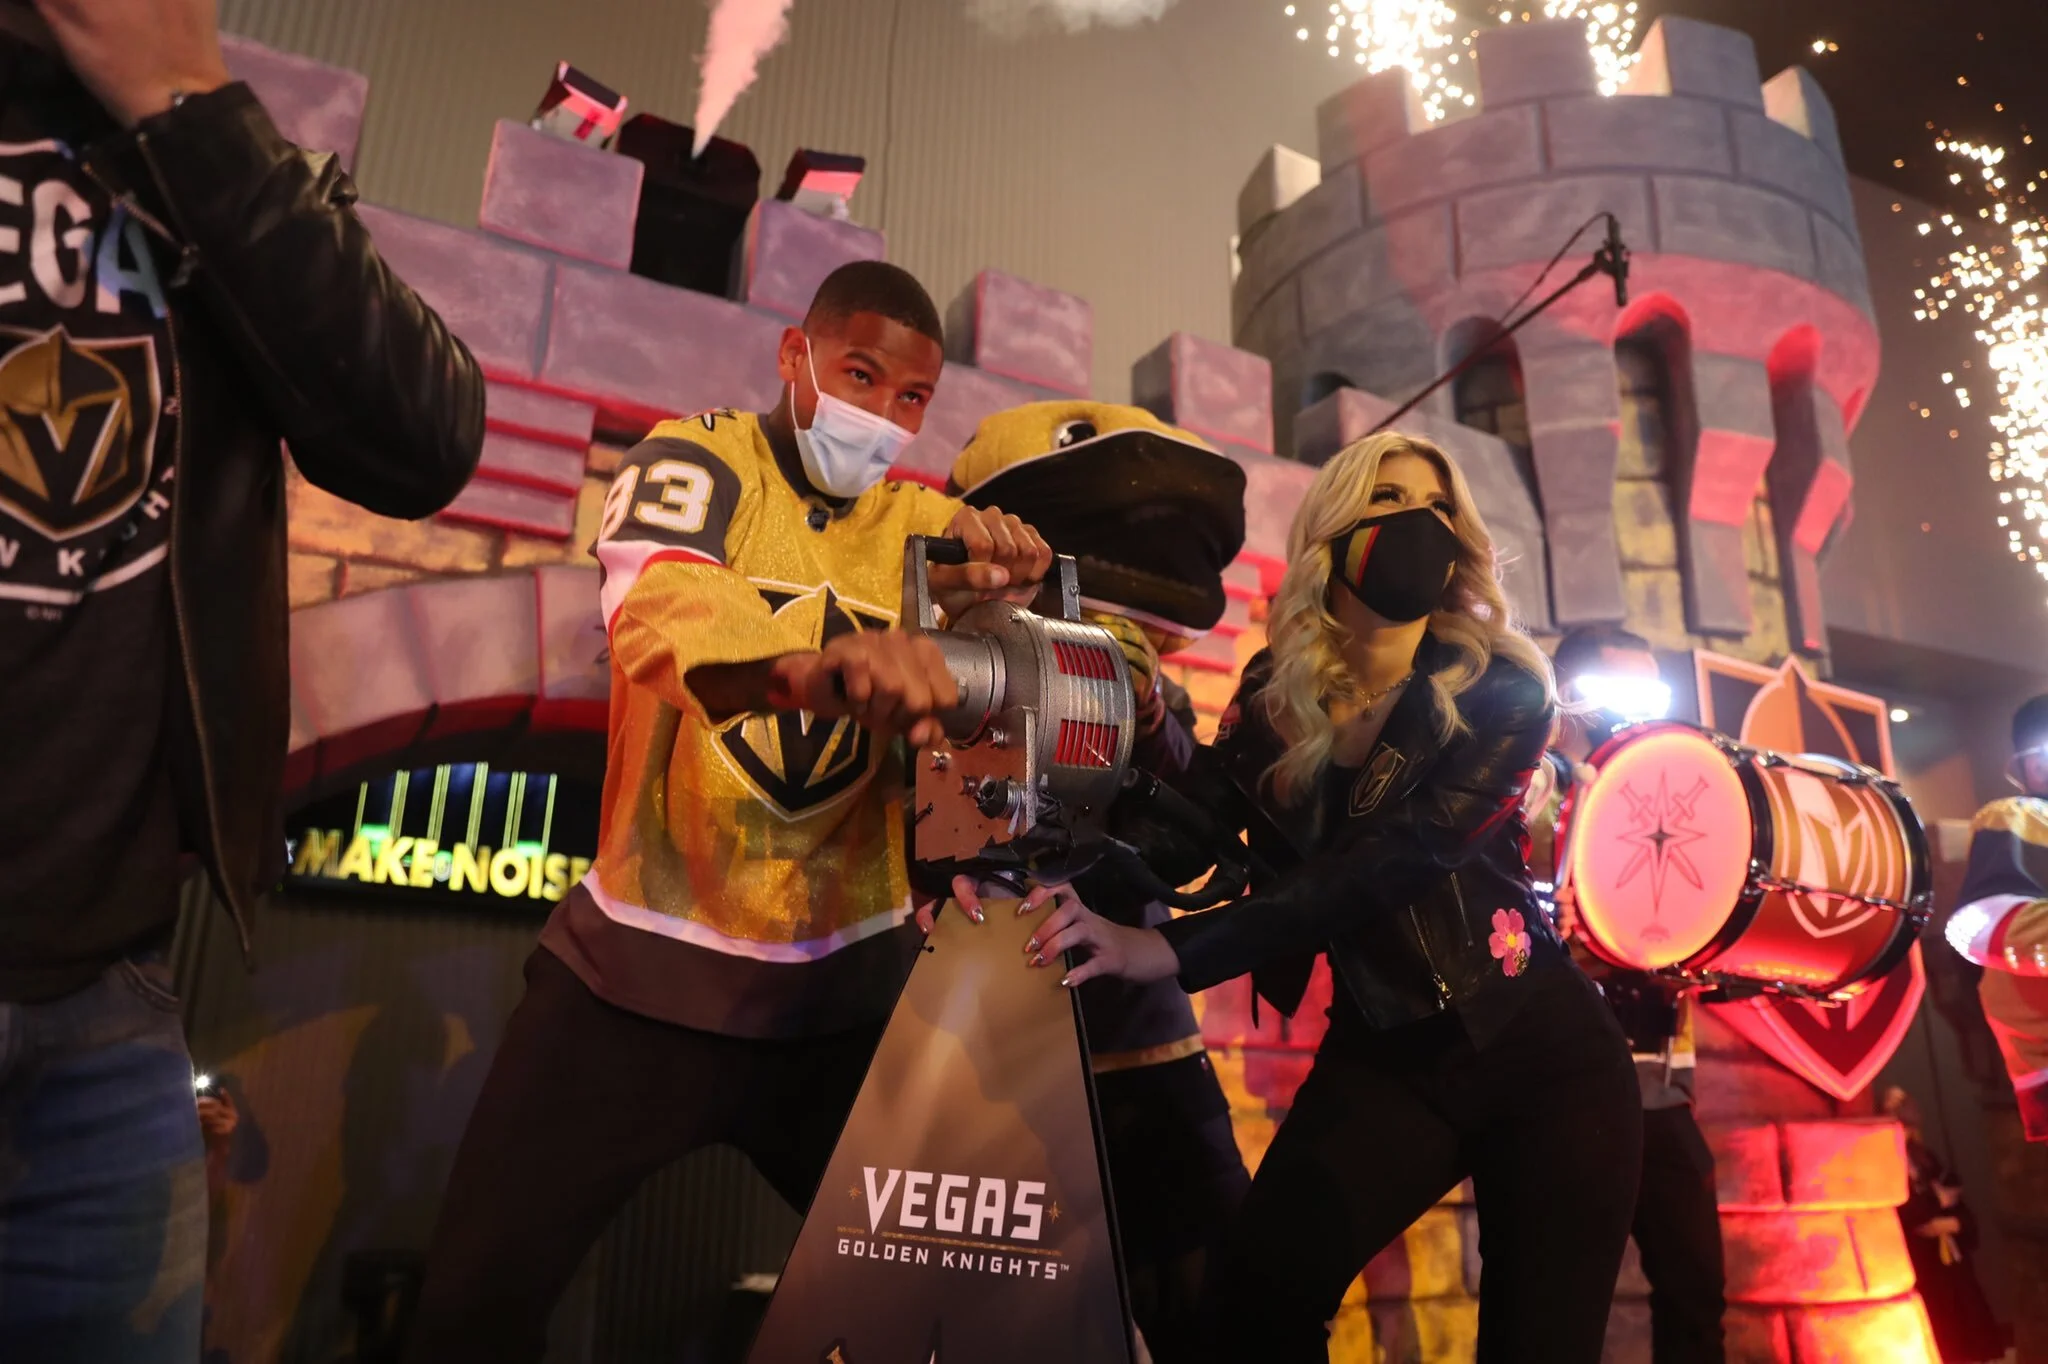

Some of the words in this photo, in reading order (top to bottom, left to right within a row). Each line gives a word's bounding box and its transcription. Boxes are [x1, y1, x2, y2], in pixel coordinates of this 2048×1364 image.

[291, 829, 434, 886] MAKE
[863, 1166, 1046, 1240] VEGAS
[838, 1239, 929, 1264] GOLDEN
